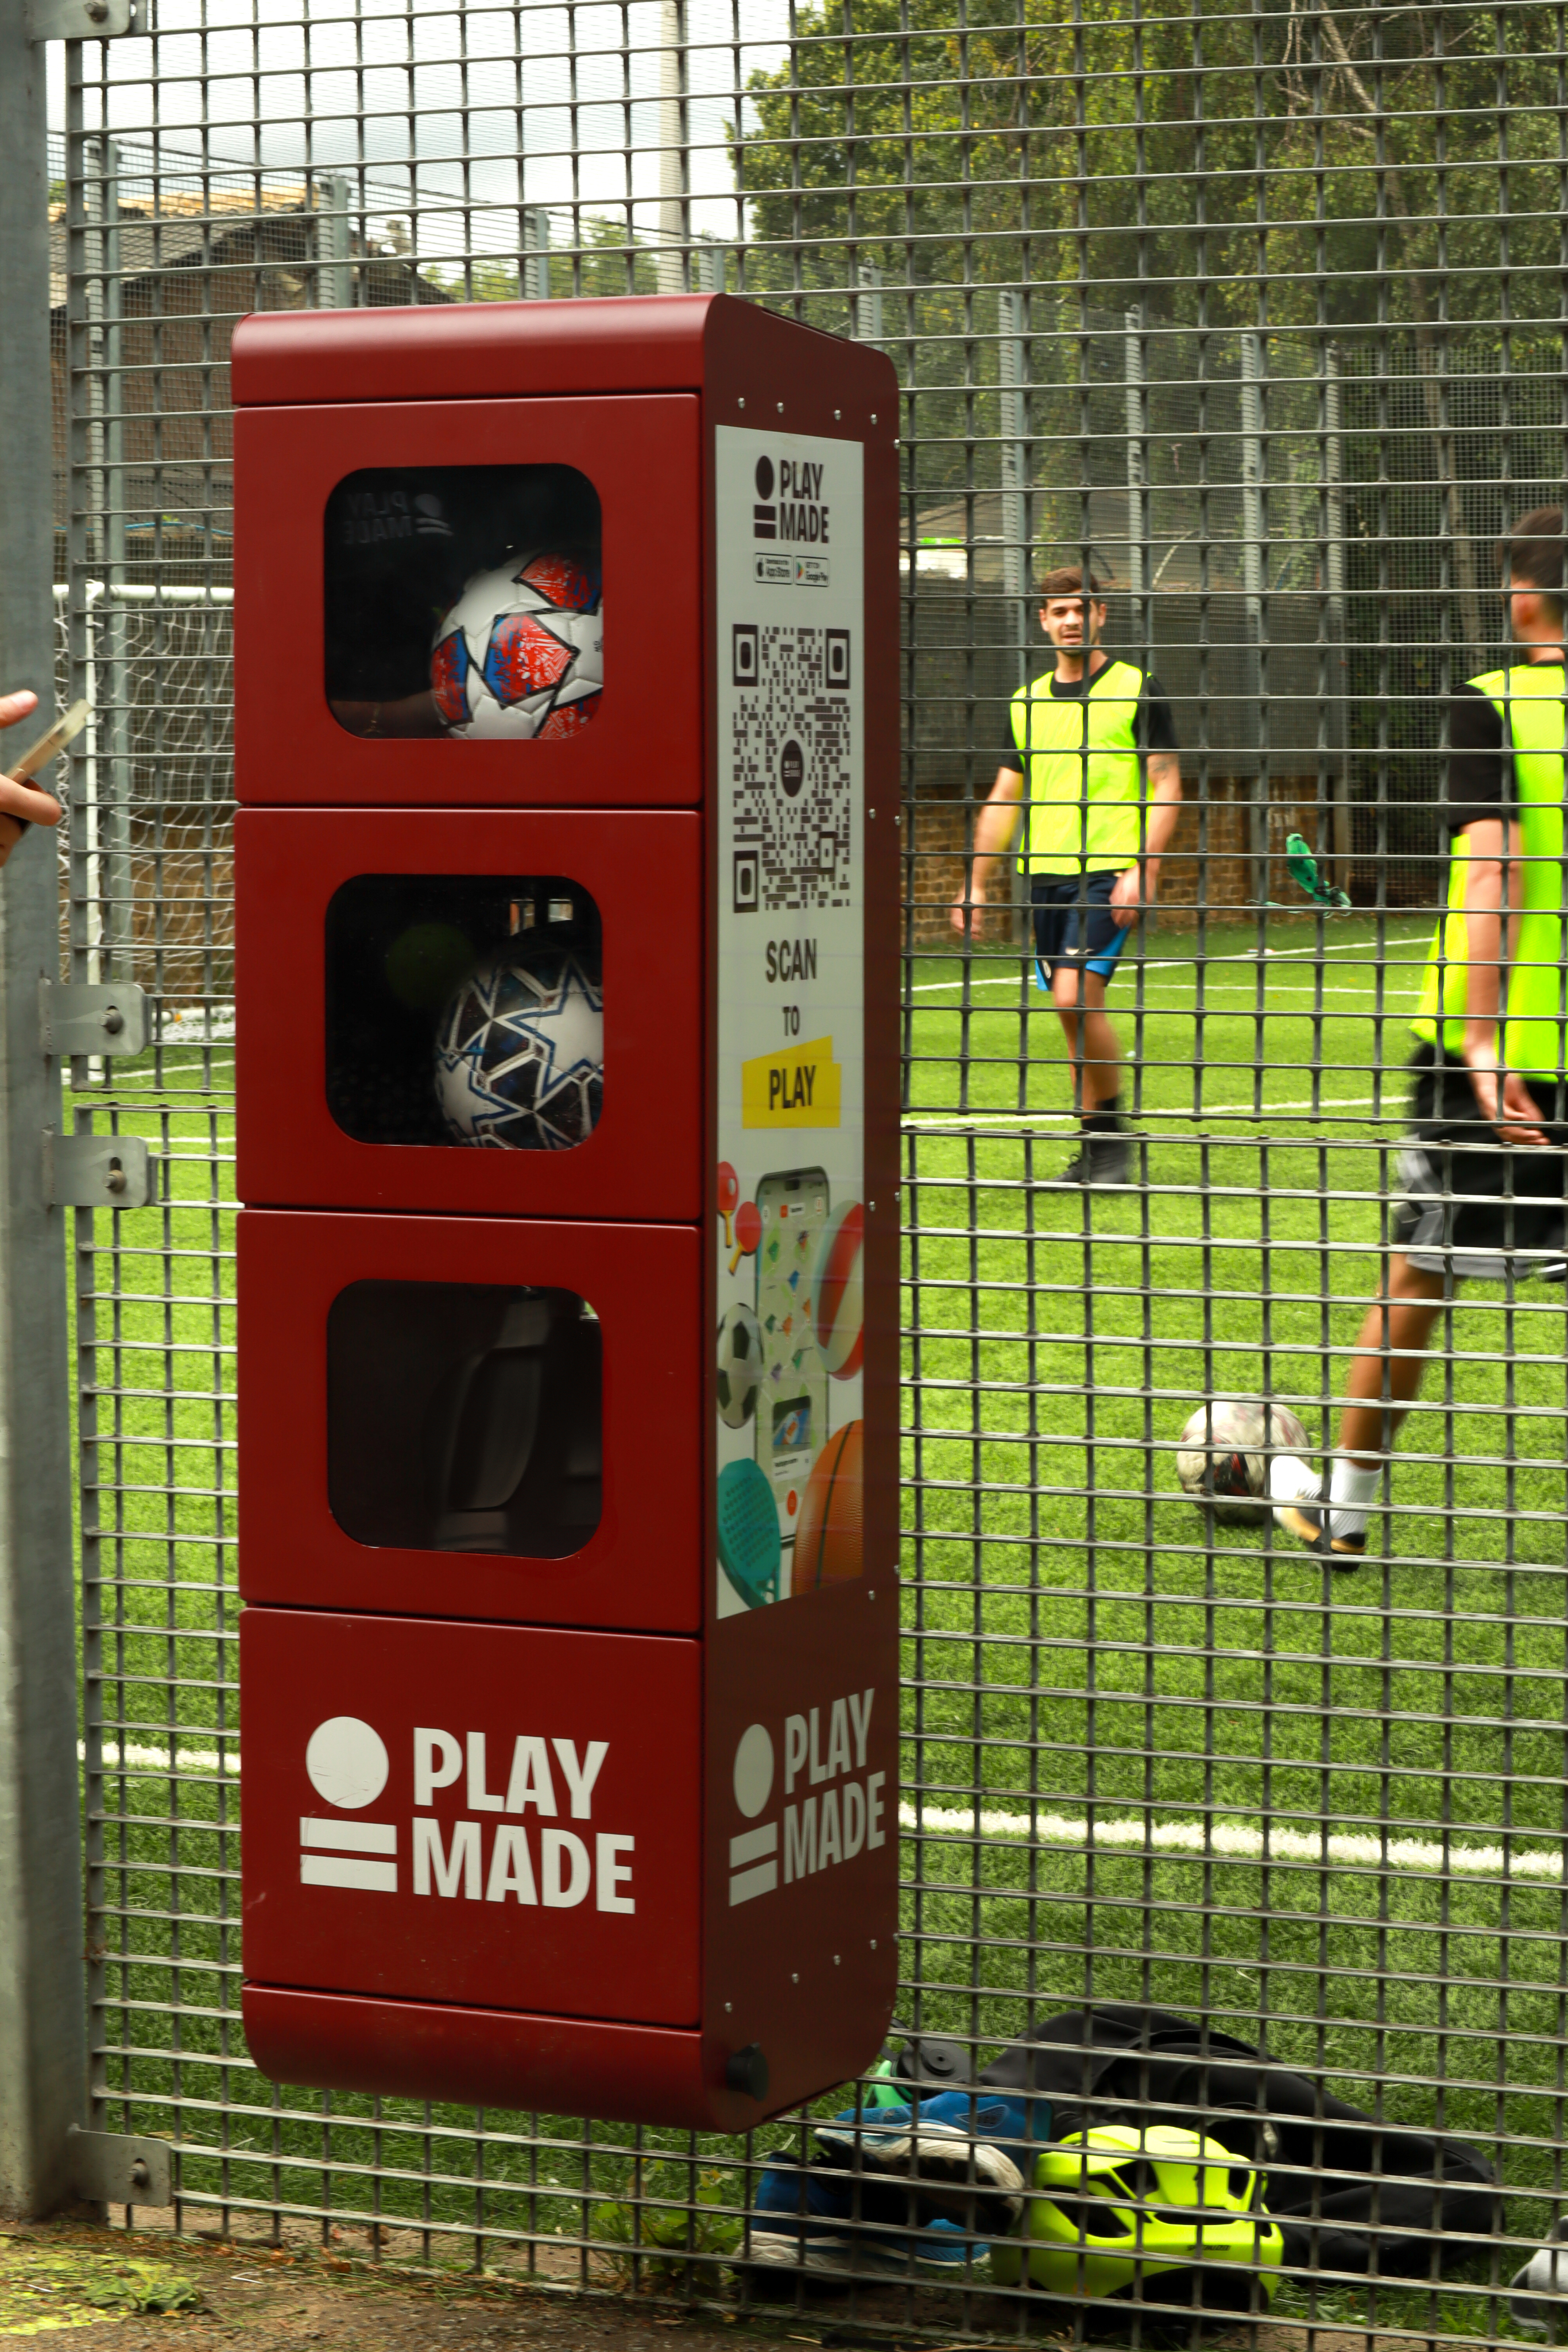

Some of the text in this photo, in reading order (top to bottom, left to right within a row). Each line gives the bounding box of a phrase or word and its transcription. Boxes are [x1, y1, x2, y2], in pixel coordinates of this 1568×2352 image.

[780, 459, 824, 501] PLAY
[780, 502, 829, 544] MADE
[765, 938, 817, 983] SCAN
[782, 1005, 800, 1036] TO
[769, 1065, 817, 1111] PLAY
[784, 1688, 876, 1795] PLAY
[413, 1727, 610, 1820] PLAY
[784, 1770, 886, 1885] MADE
[412, 1816, 636, 1914] MADE
